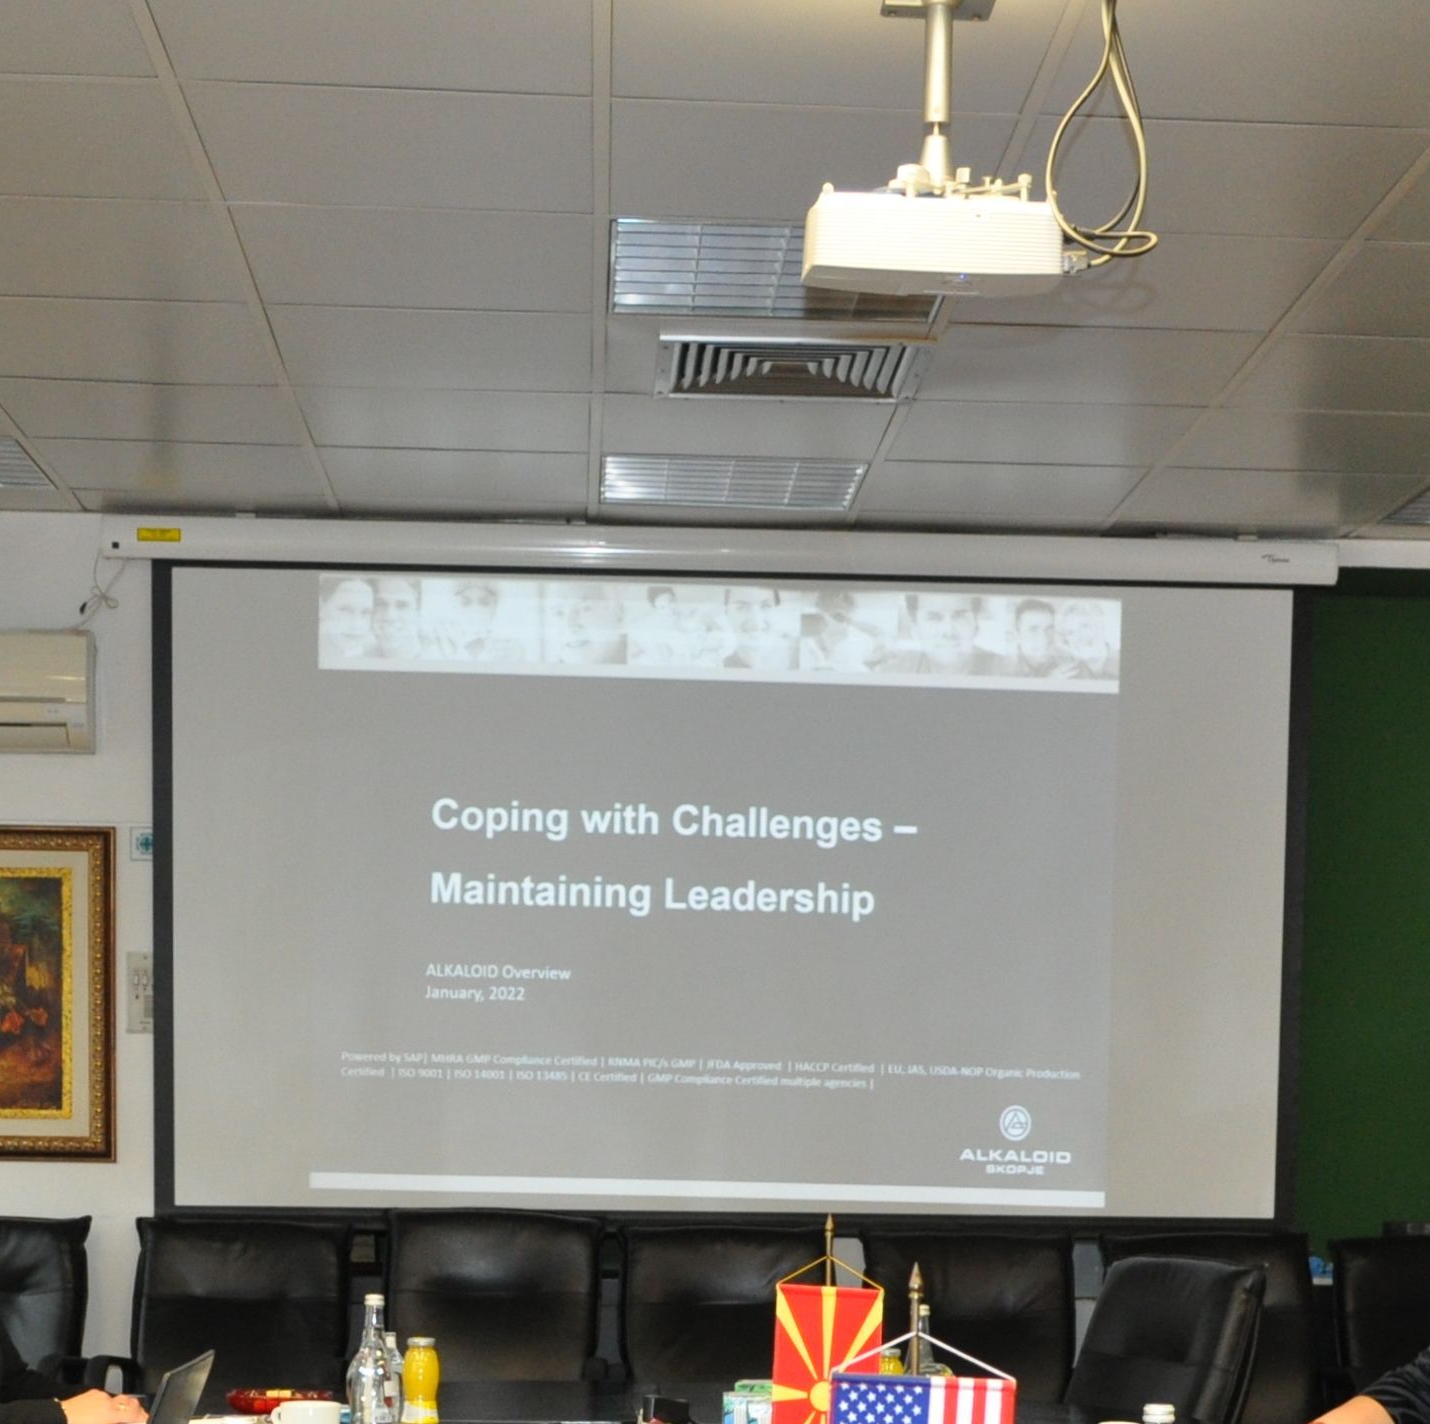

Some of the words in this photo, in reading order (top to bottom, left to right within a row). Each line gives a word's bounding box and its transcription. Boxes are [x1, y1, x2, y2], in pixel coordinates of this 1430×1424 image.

[431, 798, 569, 842] Coping
[581, 803, 659, 835] with
[672, 804, 883, 849] Challenges
[430, 872, 651, 917] Maintaining
[665, 878, 875, 922] Leadership
[425, 963, 498, 978] ALKALOID
[502, 964, 572, 980] Overview
[425, 985, 484, 1003] January,
[489, 986, 525, 1001] 2022
[340, 1051, 386, 1062] Powered
[389, 1052, 401, 1064] by
[465, 1054, 492, 1064] GMP
[493, 1054, 551, 1066] Compliance
[554, 1055, 597, 1067] Certified
[671, 1058, 695, 1068] GMP
[733, 1060, 782, 1072] Approved
[795, 1062, 829, 1072] HACCP
[831, 1062, 874, 1073] Certified
[1026, 1068, 1081, 1080] Production
[340, 1066, 385, 1077] Certified
[398, 1068, 416, 1078] ISO
[454, 1069, 471, 1079] ISO
[516, 1070, 533, 1080] ISO
[593, 1071, 637, 1083] Certified
[647, 1073, 672, 1083] GMP
[674, 1073, 733, 1085] Compliance
[735, 1075, 779, 1086] Certified
[780, 1076, 821, 1088] multiple
[823, 1077, 866, 1090] agencies
[959, 1148, 1072, 1164] ALKALOID
[986, 1164, 1045, 1175] SKOPJE
